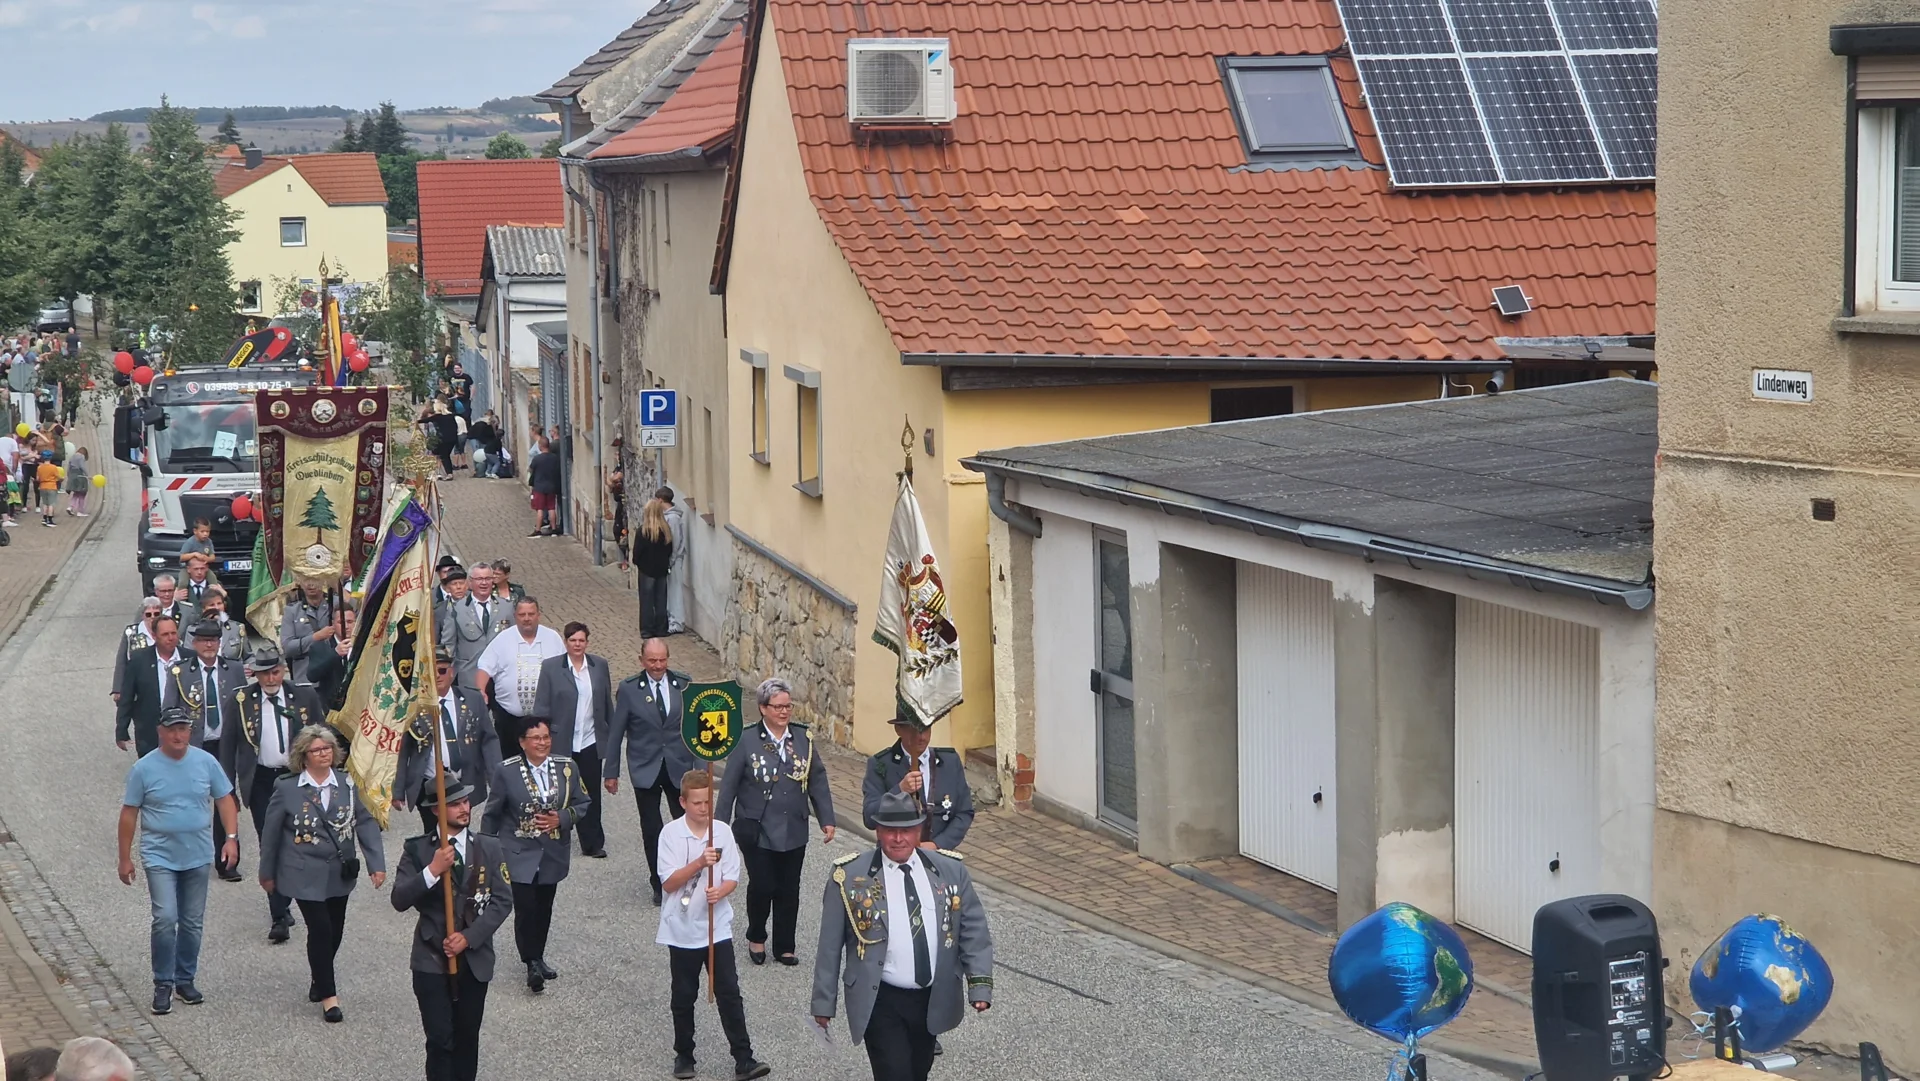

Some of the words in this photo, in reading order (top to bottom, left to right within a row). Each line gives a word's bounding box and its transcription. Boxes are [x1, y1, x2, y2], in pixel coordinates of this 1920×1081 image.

[1757, 372, 1808, 399] Lindenweg
[649, 395, 668, 422] P
[219, 438, 234, 451] 32
[286, 452, 355, 473] Kreisschützenbund
[295, 468, 345, 484] Quedlinburg
[689, 688, 737, 713] SCHÜTZENGESELLSCHAFT
